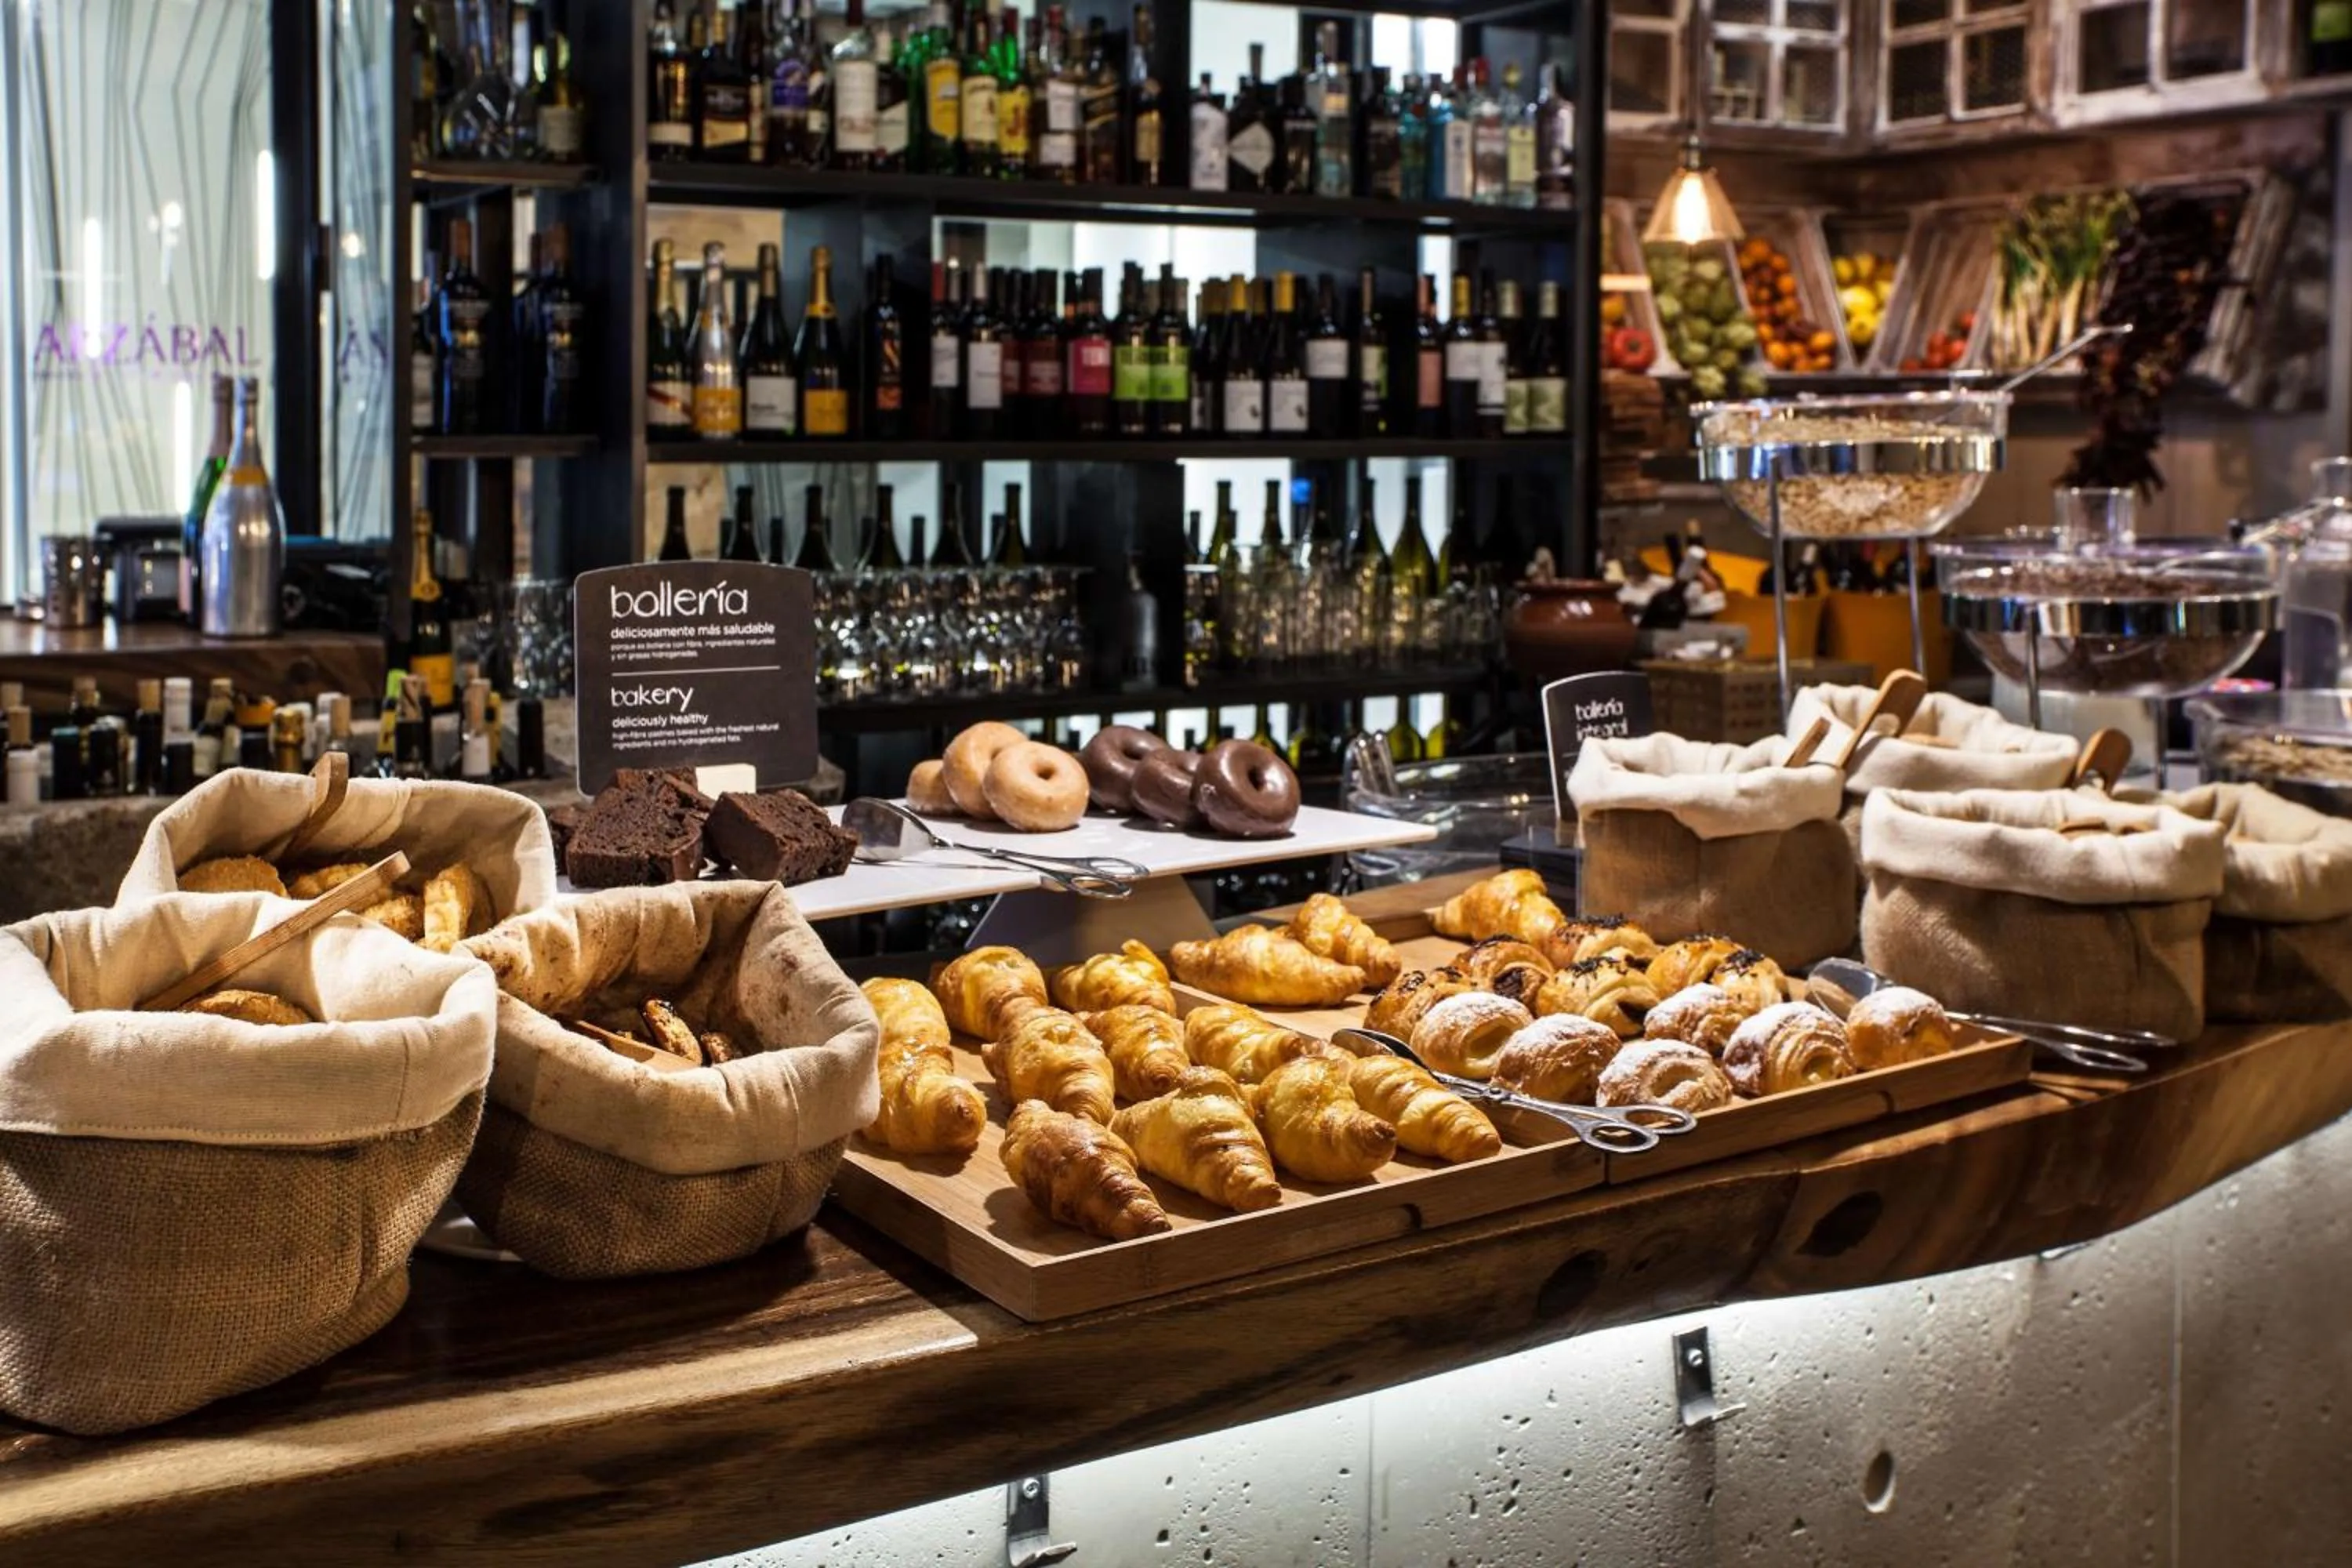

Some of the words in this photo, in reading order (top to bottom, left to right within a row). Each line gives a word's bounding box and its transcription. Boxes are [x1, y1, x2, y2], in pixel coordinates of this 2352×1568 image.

[611, 580, 748, 619] bollería
[611, 626, 695, 639] deliciosamente
[698, 623, 721, 636] más
[723, 622, 775, 635] saludable
[611, 683, 694, 713] bakery
[612, 716, 668, 728] deliciously
[670, 713, 710, 725] healthy
